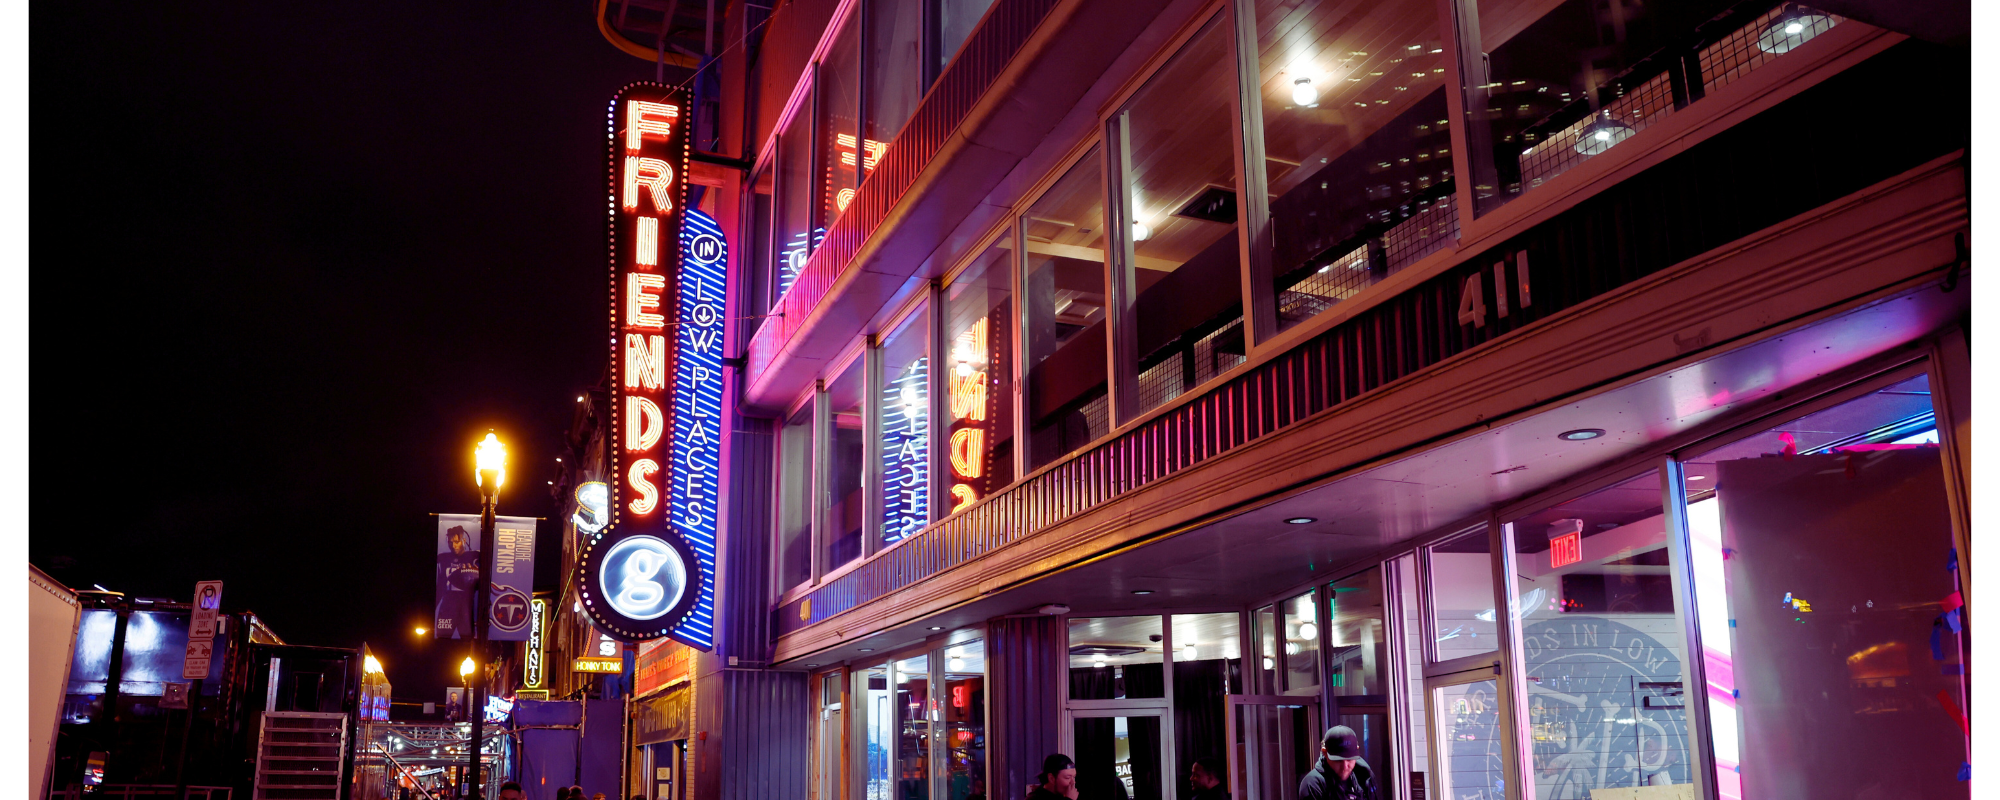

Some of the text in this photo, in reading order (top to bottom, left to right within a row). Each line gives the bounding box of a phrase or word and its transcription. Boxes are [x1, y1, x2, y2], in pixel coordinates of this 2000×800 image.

[699, 240, 714, 257] IN
[622, 99, 679, 515] FRIENDS
[1458, 249, 1531, 329] 411
[685, 366, 710, 526] PLACES
[496, 528, 516, 574] HOPKINS
[515, 529, 533, 562] DEANDRE
[528, 603, 542, 685] MERCHANTS
[576, 661, 621, 672] HONKY TONK
[1571, 623, 1598, 647] IN
[1609, 629, 1668, 673] LOW
